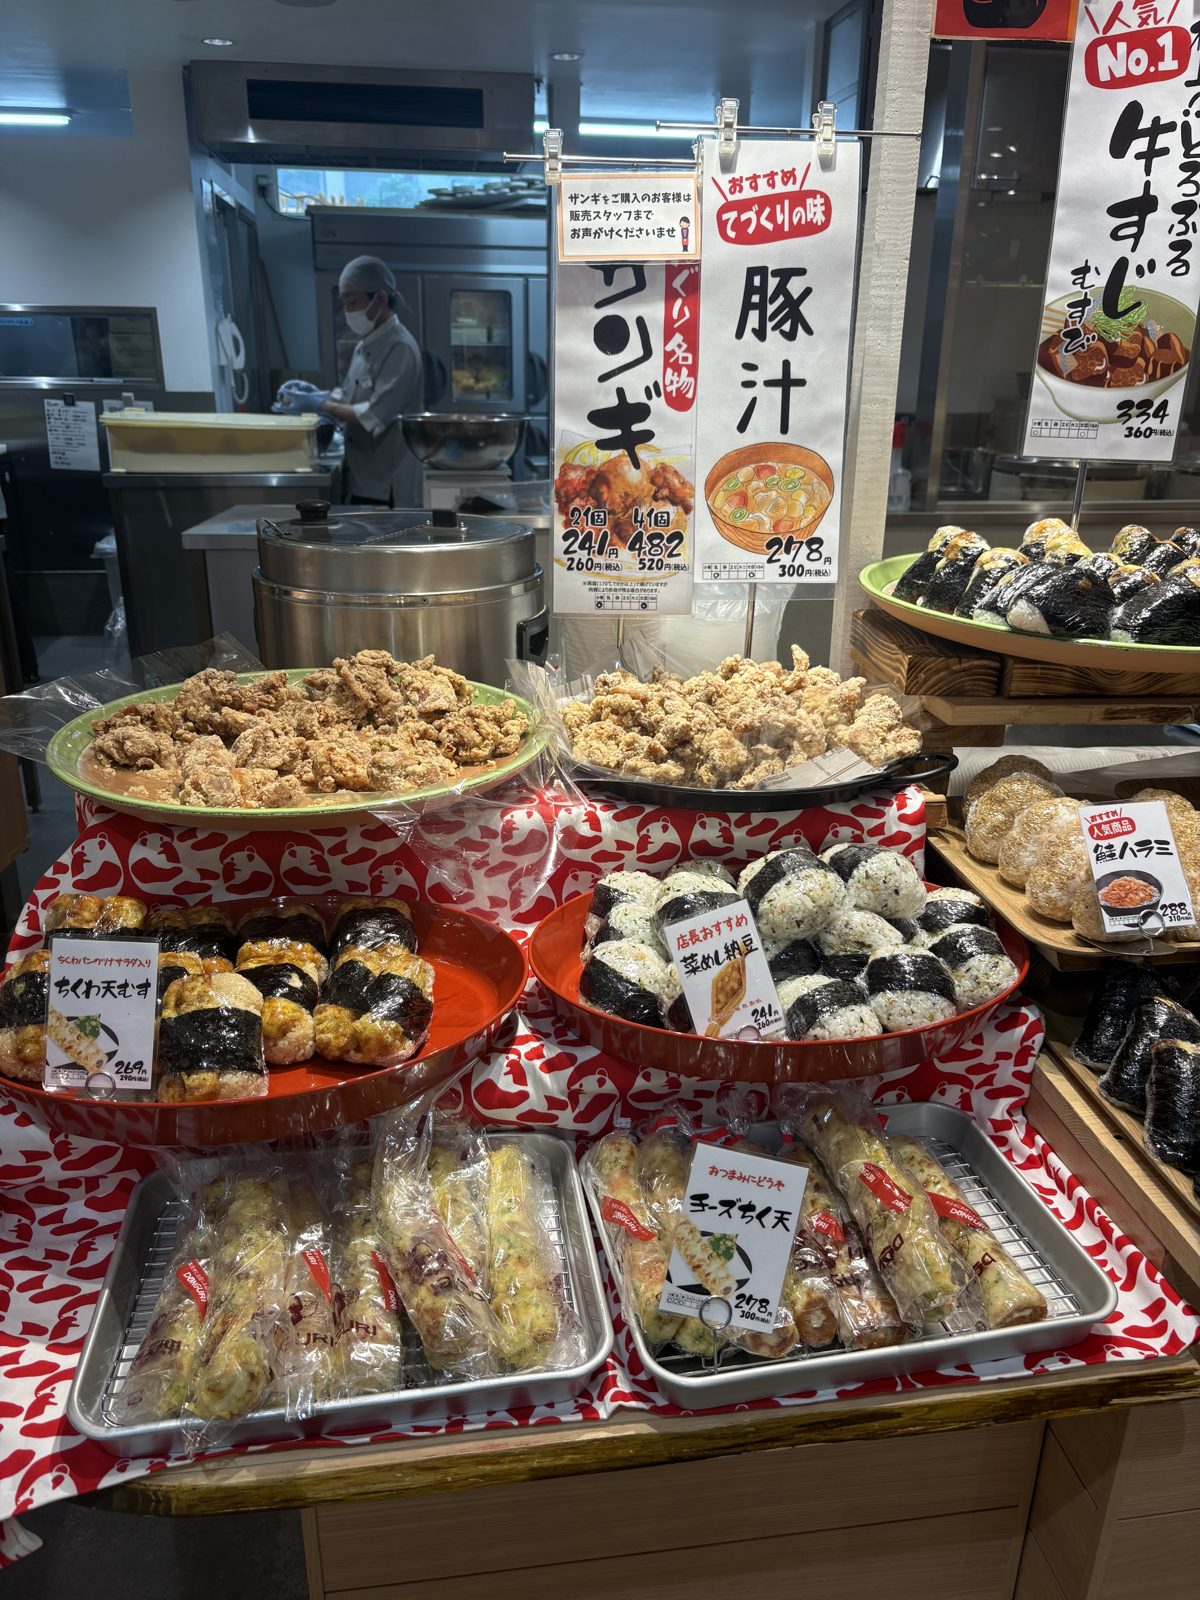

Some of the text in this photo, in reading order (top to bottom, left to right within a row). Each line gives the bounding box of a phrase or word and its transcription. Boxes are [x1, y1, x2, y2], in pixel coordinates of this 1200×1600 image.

[1102, 0, 1164, 35] 人気
[1097, 31, 1178, 82] No.1
[728, 167, 798, 195] おすすめ
[568, 191, 692, 205] ザンギをご購入のお客様は
[1102, 100, 1177, 320] 牛すじ
[569, 209, 654, 222] 販売スタッフまで
[721, 194, 827, 239] てづくりの味
[570, 227, 676, 239] お声がけくださいませ
[1061, 259, 1101, 355] むすび
[664, 260, 699, 399] ぐり名物
[735, 265, 815, 436] 豚汁
[1116, 399, 1170, 425] 334
[570, 507, 670, 528] 2個 4個
[562, 529, 685, 559] 241円 482
[765, 535, 832, 565] 278円
[566, 558, 689, 572] 260円(税込) 520円(税込)
[778, 564, 832, 577] 300円(税込)
[1089, 809, 1119, 822] おすすめ
[1093, 820, 1133, 837] 人気商品
[1093, 839, 1174, 862] 鮭ハラミ
[677, 914, 748, 950] 店長おすすめ
[57, 955, 151, 968] ちくわパンのツナサラダ入り
[680, 933, 759, 978] 菜めし納豆
[54, 976, 151, 999] ちくわ天むす
[709, 1165, 785, 1192] おつまみにどうぞ
[690, 1193, 792, 1232] チーズちく天
